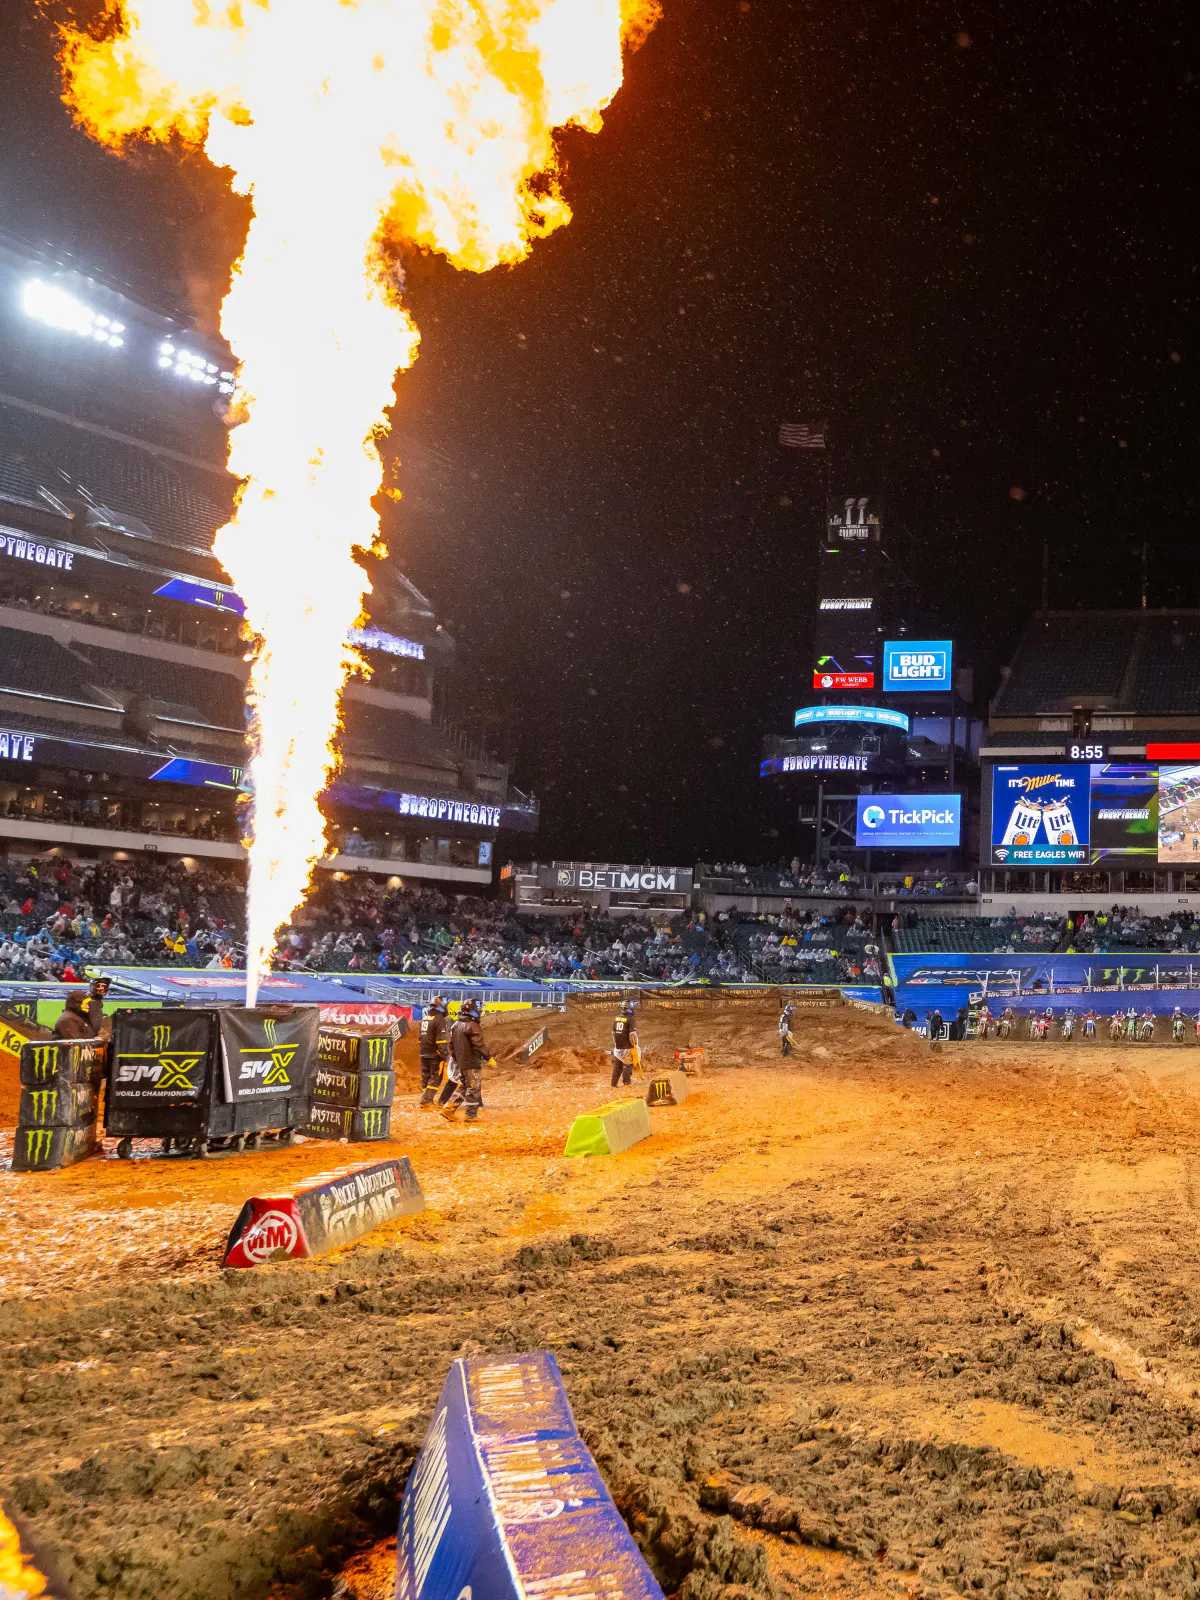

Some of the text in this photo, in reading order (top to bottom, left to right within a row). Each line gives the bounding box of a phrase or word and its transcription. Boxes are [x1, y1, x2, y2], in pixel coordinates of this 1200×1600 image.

[899, 654, 936, 666] BUD
[892, 666, 942, 678] LIGHT
[1070, 745, 1103, 759] 8:55
[783, 755, 867, 771] #DROPTHEGATE
[1008, 779, 1022, 788] IT'S
[1021, 774, 1062, 793] Miller
[888, 809, 954, 824] TickPick
[1015, 811, 1041, 829] Lite
[1048, 812, 1071, 831] Lite
[1014, 851, 1034, 859] FREE
[1035, 851, 1066, 859] EAGLES
[579, 871, 676, 890] BETMGM
[912, 969, 1020, 977] peacock
[336, 1013, 400, 1025] HONDA
[616, 1022, 624, 1031] 10
[115, 1058, 199, 1089] SMX
[238, 1051, 296, 1085] SMX
[239, 1084, 291, 1095] WORLD CHAMPIONSHIP
[330, 1167, 395, 1208] ROCKY MOUNTAIN
